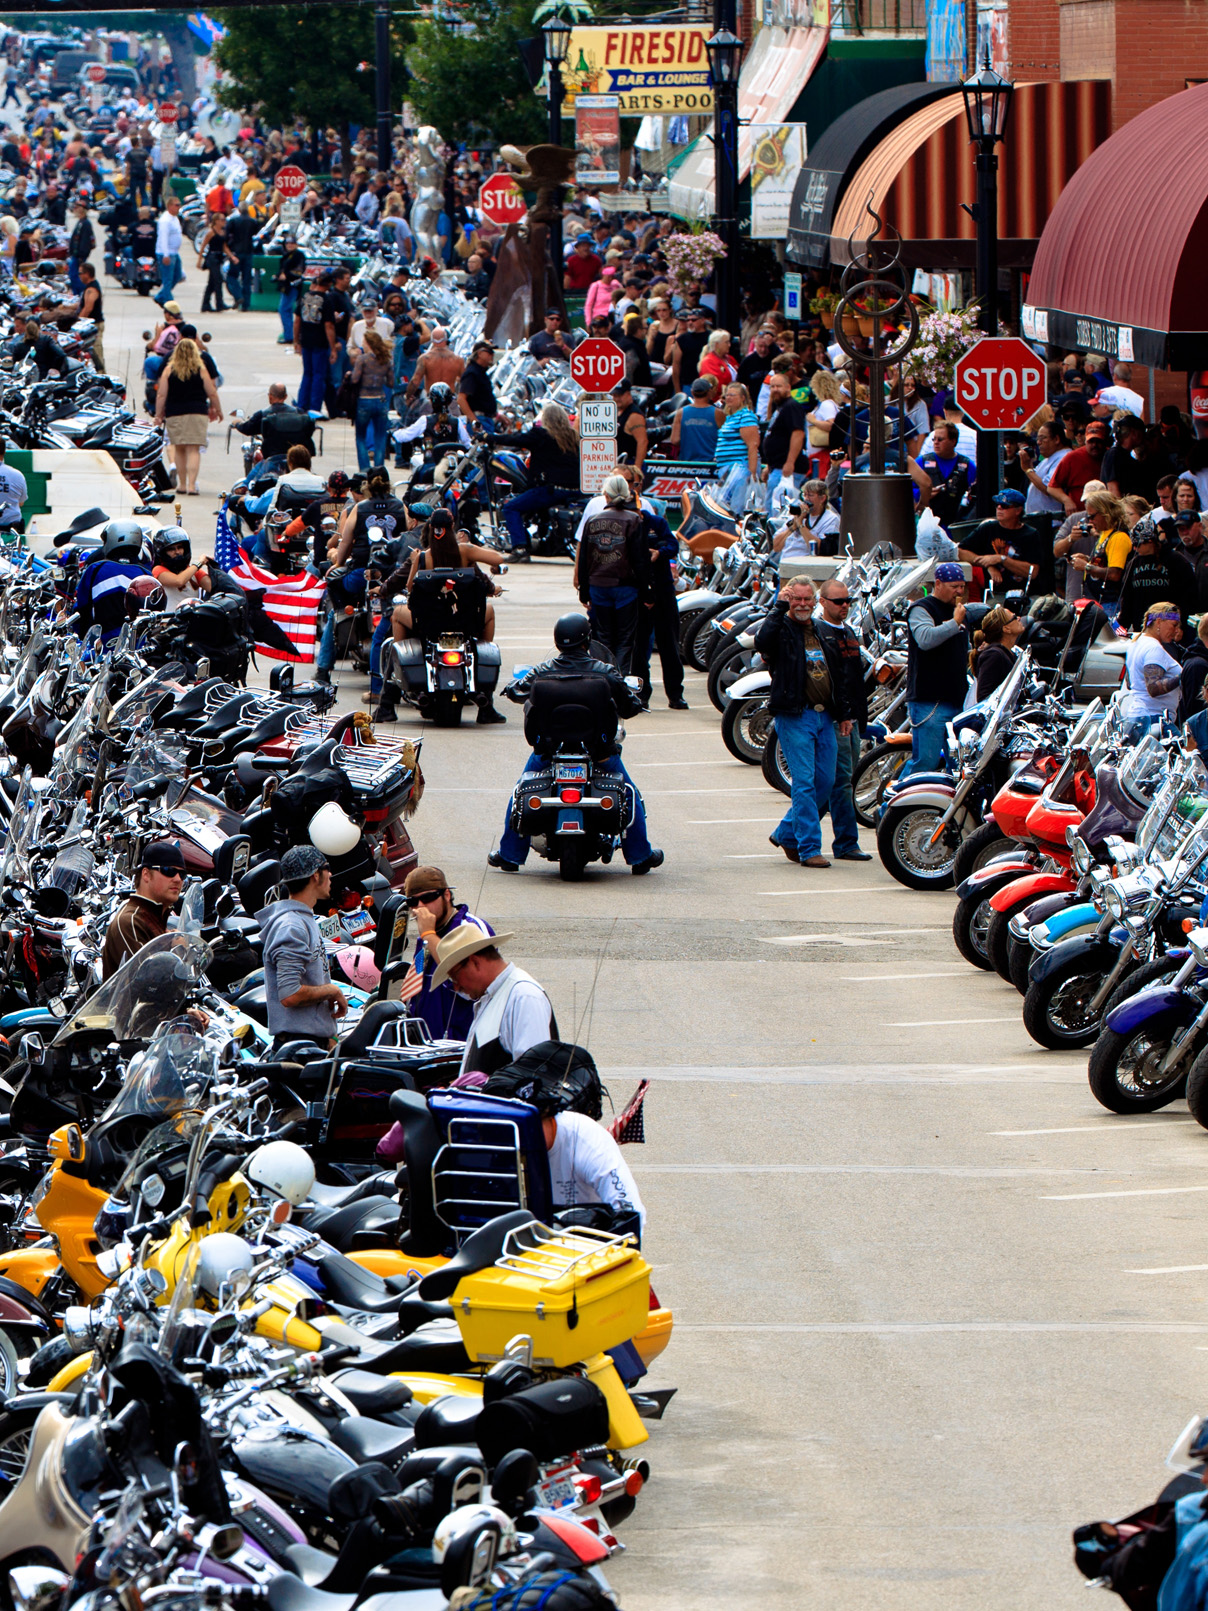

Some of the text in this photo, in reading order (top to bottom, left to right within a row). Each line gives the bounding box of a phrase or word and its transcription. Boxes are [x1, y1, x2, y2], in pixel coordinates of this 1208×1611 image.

[605, 31, 714, 65] FIRESID
[617, 73, 709, 86] BAR & LOUNGE
[276, 175, 305, 188] STOP
[573, 355, 622, 376] STOP
[962, 368, 1040, 401] STOP
[586, 406, 611, 417] NO U
[584, 422, 614, 432] TURNS
[592, 442, 606, 452] NO
[583, 454, 614, 462] PARKING
[646, 466, 711, 475] THE OFFICIAL
